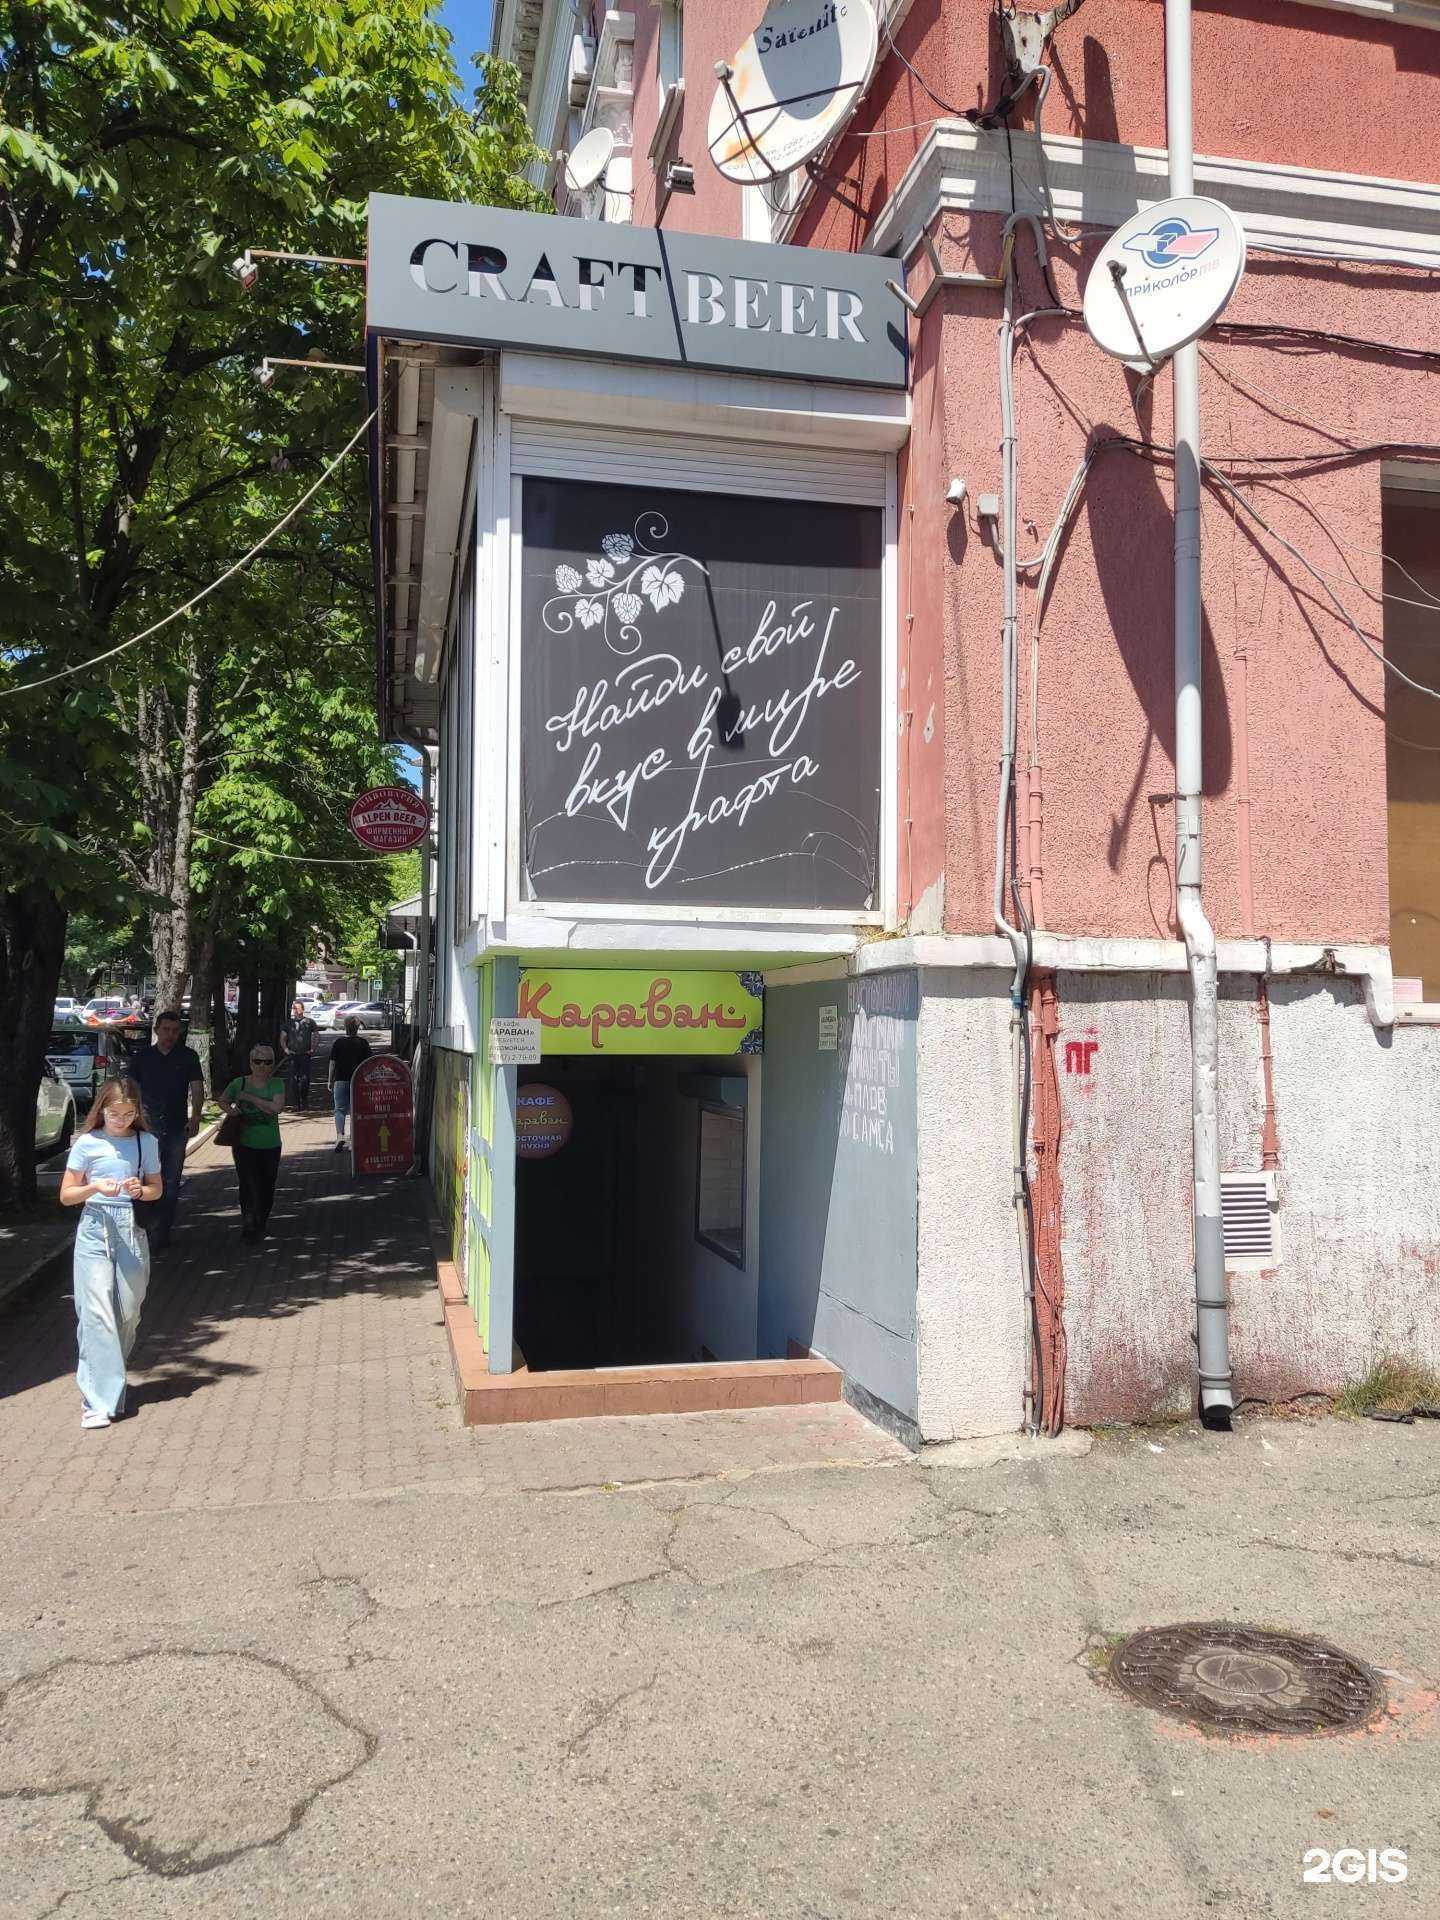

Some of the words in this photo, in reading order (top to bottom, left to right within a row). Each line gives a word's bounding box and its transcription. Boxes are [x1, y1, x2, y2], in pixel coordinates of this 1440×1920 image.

[409, 237, 662, 318] CRAFT
[681, 268, 869, 344] BEER
[545, 653, 709, 752] Найди
[721, 599, 816, 675] свой
[565, 742, 671, 831] вкус
[687, 686, 720, 760] в
[724, 606, 862, 758] мире
[362, 811, 391, 825] ALPEN
[393, 812, 416, 825] BEER
[644, 743, 820, 890] крафта
[373, 835, 407, 844] МАГАЗИН
[518, 977, 747, 1048] Караван
[1064, 1041, 1099, 1075] ПГ
[516, 1096, 556, 1106] КАФЕ
[516, 1110, 568, 1129] араван
[852, 1114, 895, 1155] САМСА
